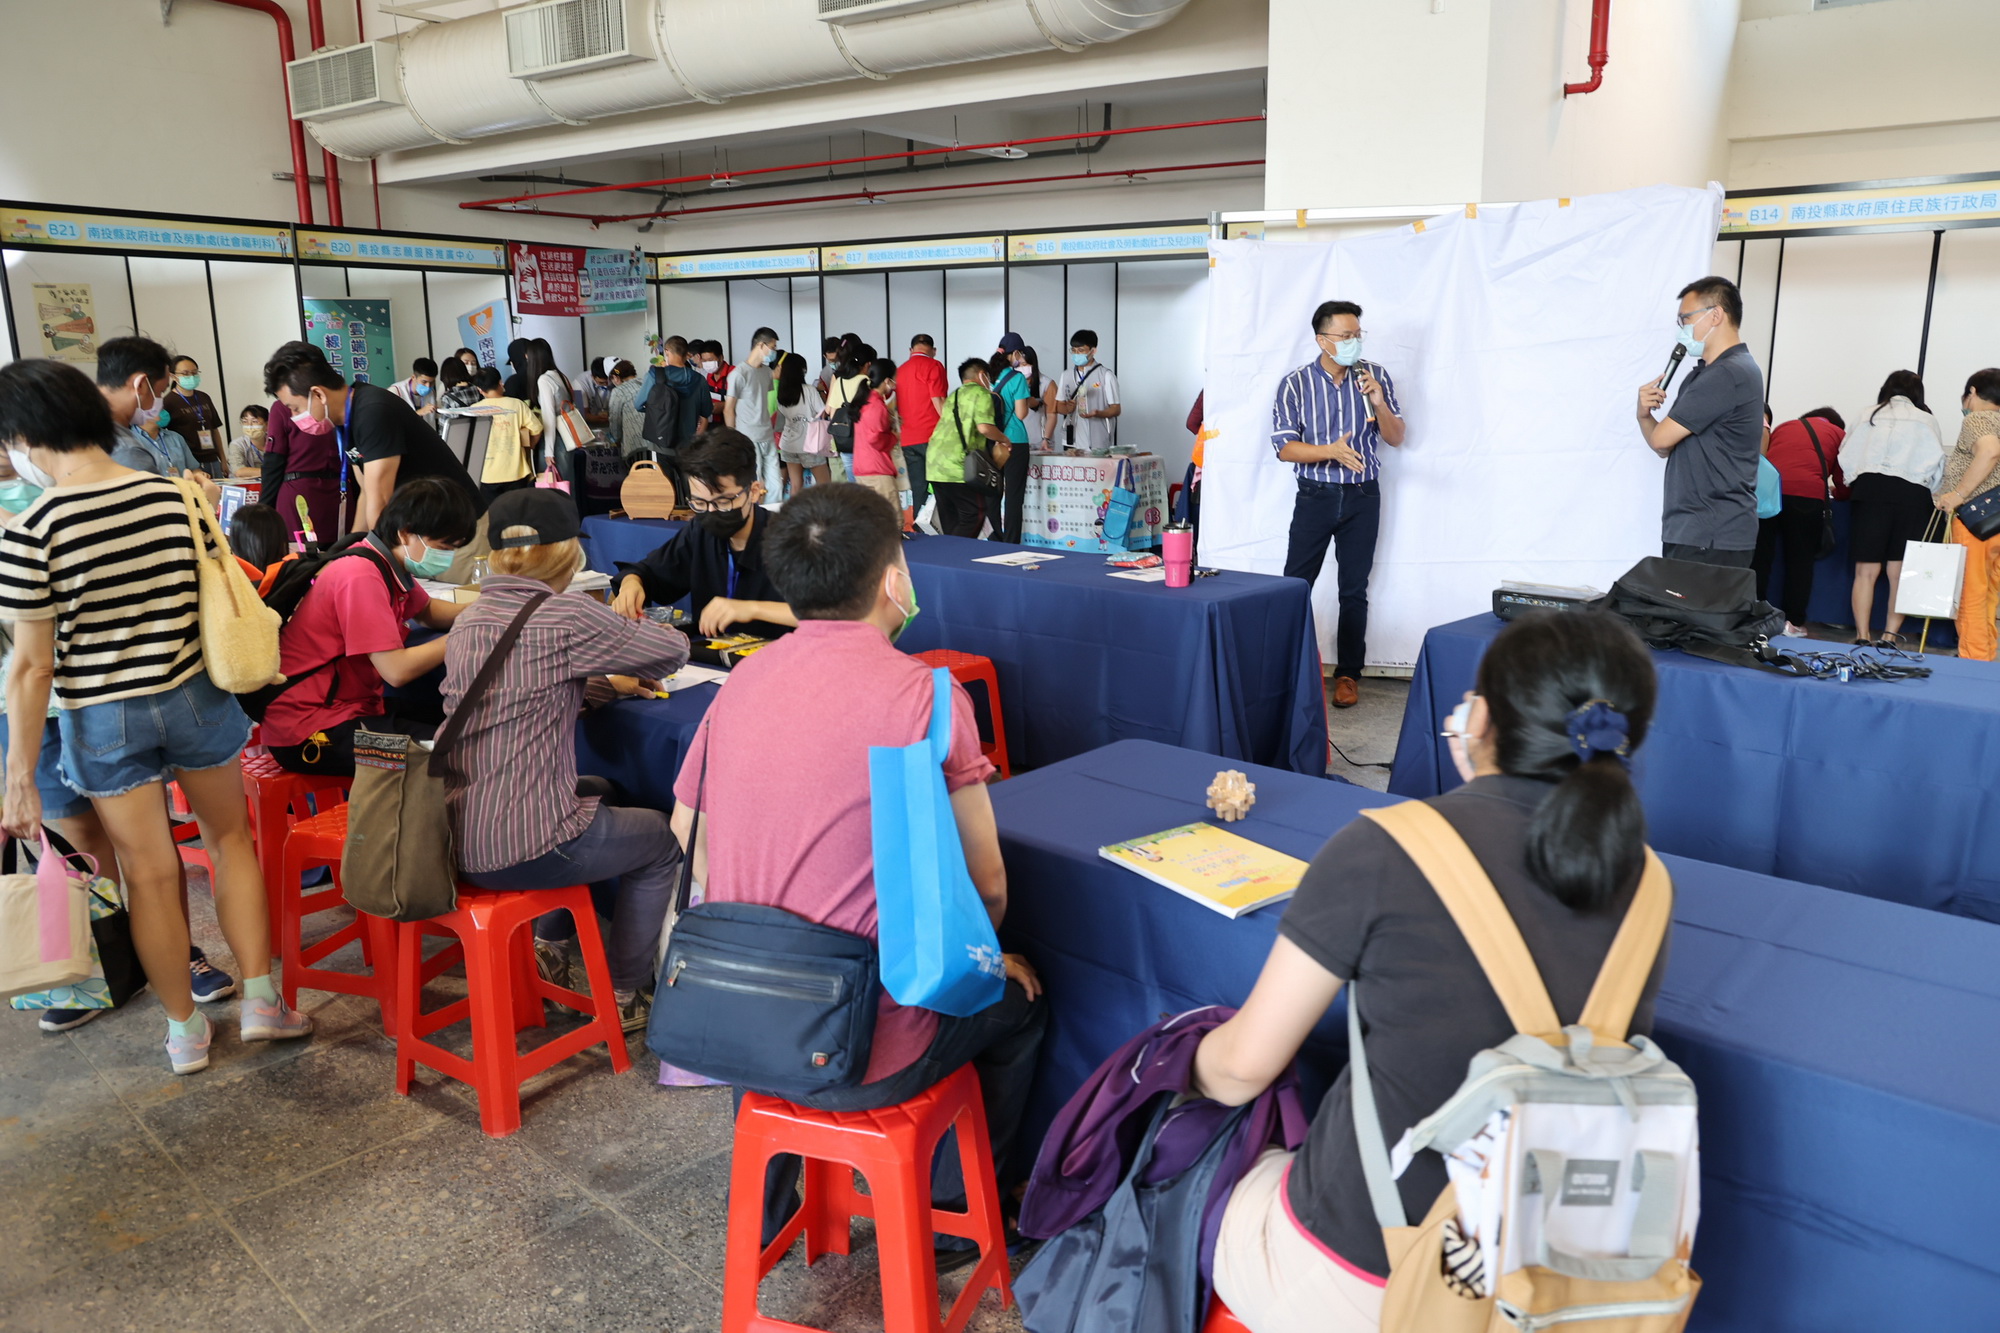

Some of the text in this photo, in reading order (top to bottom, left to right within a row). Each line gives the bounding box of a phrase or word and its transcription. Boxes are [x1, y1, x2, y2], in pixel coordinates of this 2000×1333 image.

[1749, 195, 1998, 222] B14 南投縣政府原住民族行政局
[48, 223, 276, 250] B21 南投縣政府社會及勞動處(社會福利科)
[331, 242, 475, 261] B20 南投縣志願服務推廣中心
[1036, 242, 1054, 252] B16
[845, 253, 862, 262] B17
[325, 334, 345, 377] 線上
[1027, 465, 1105, 482] 心提供的服務：
